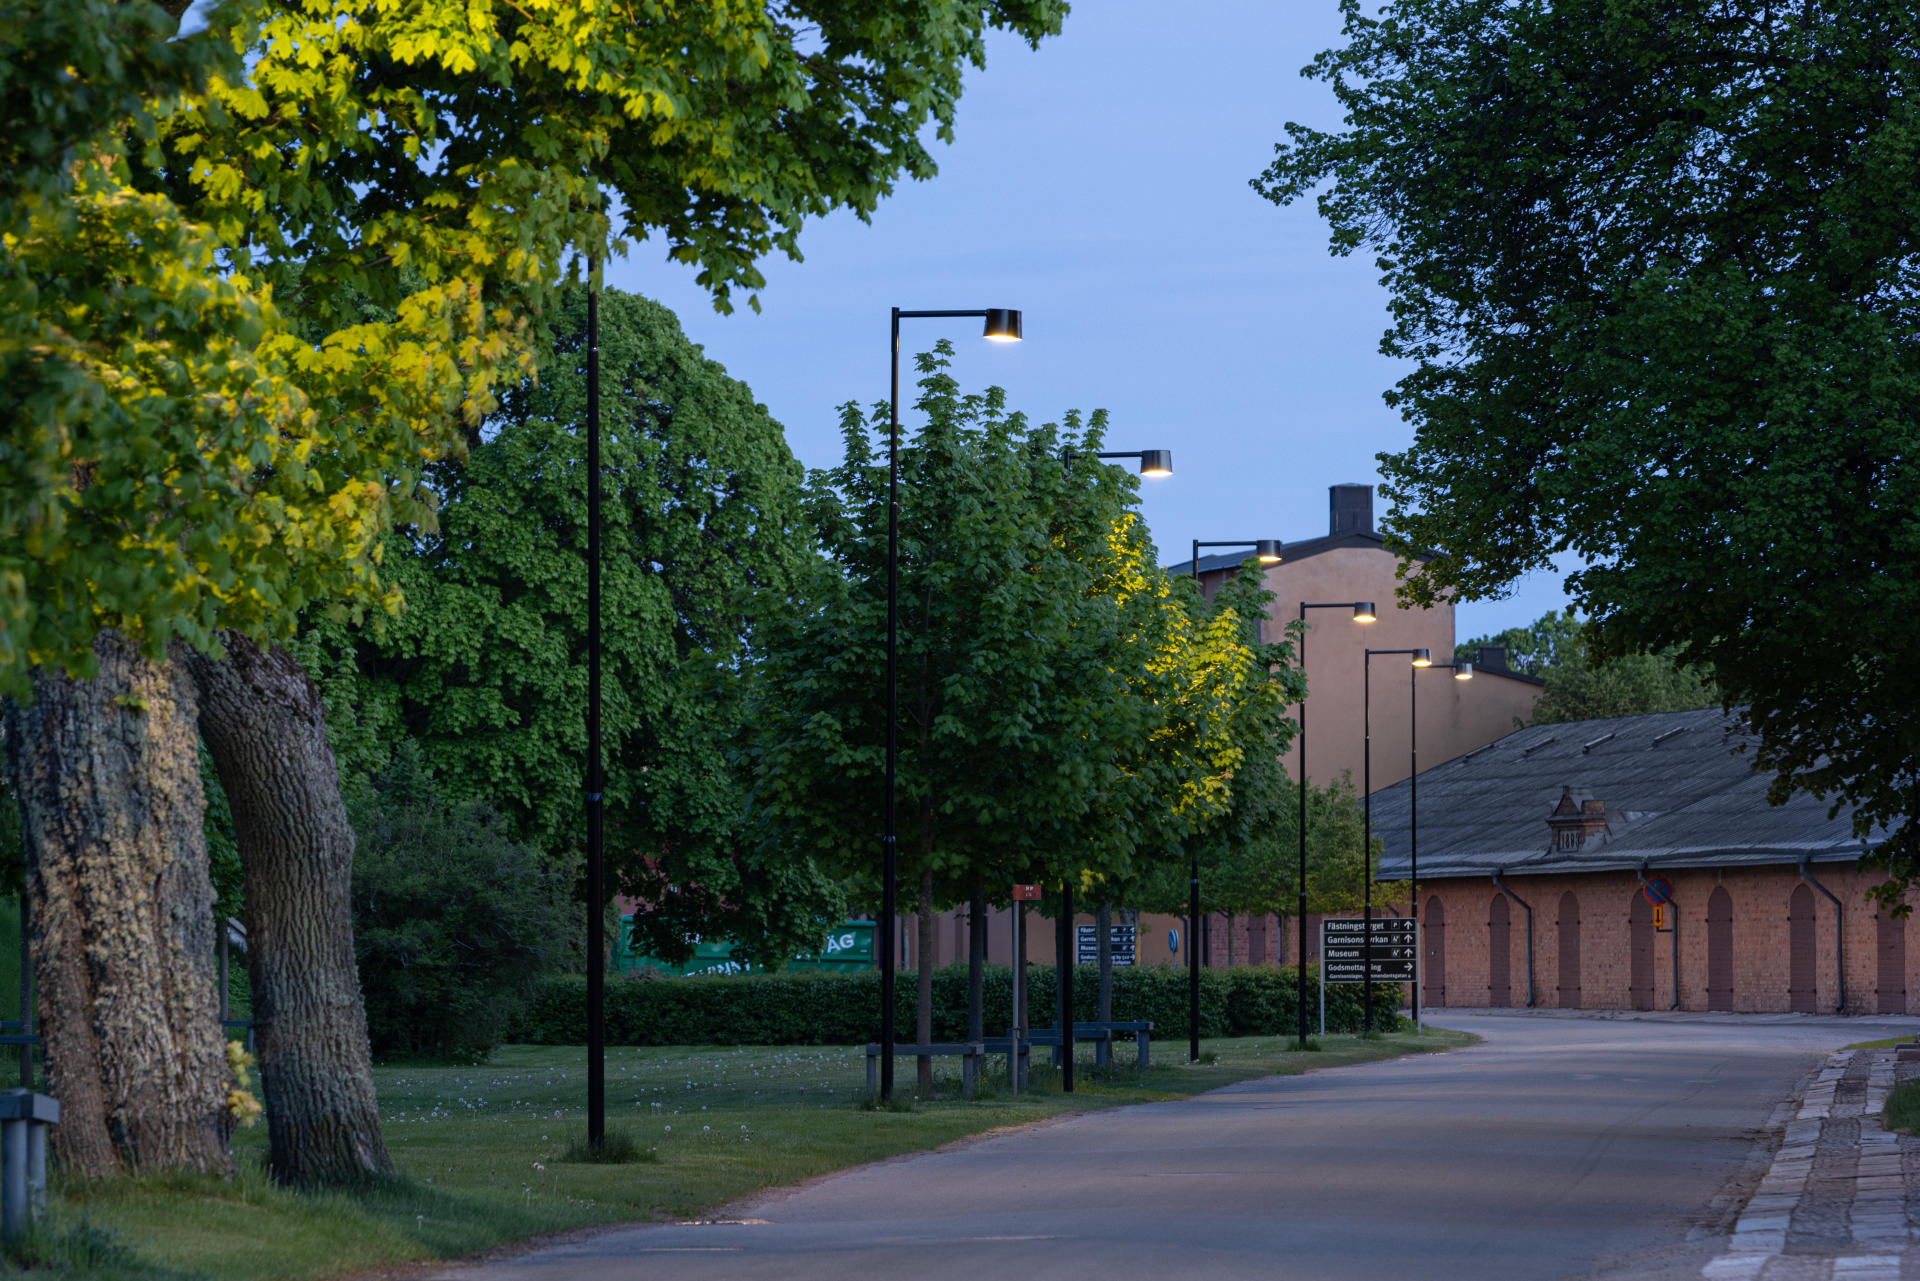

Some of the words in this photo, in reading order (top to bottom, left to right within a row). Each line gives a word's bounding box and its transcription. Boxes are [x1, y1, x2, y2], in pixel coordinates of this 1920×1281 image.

[1327, 921, 1384, 931] Fästningstget
[1327, 935, 1389, 944] Garnisonsrkan
[1328, 949, 1359, 957] Museum
[1328, 963, 1382, 972] Godsmottaging
